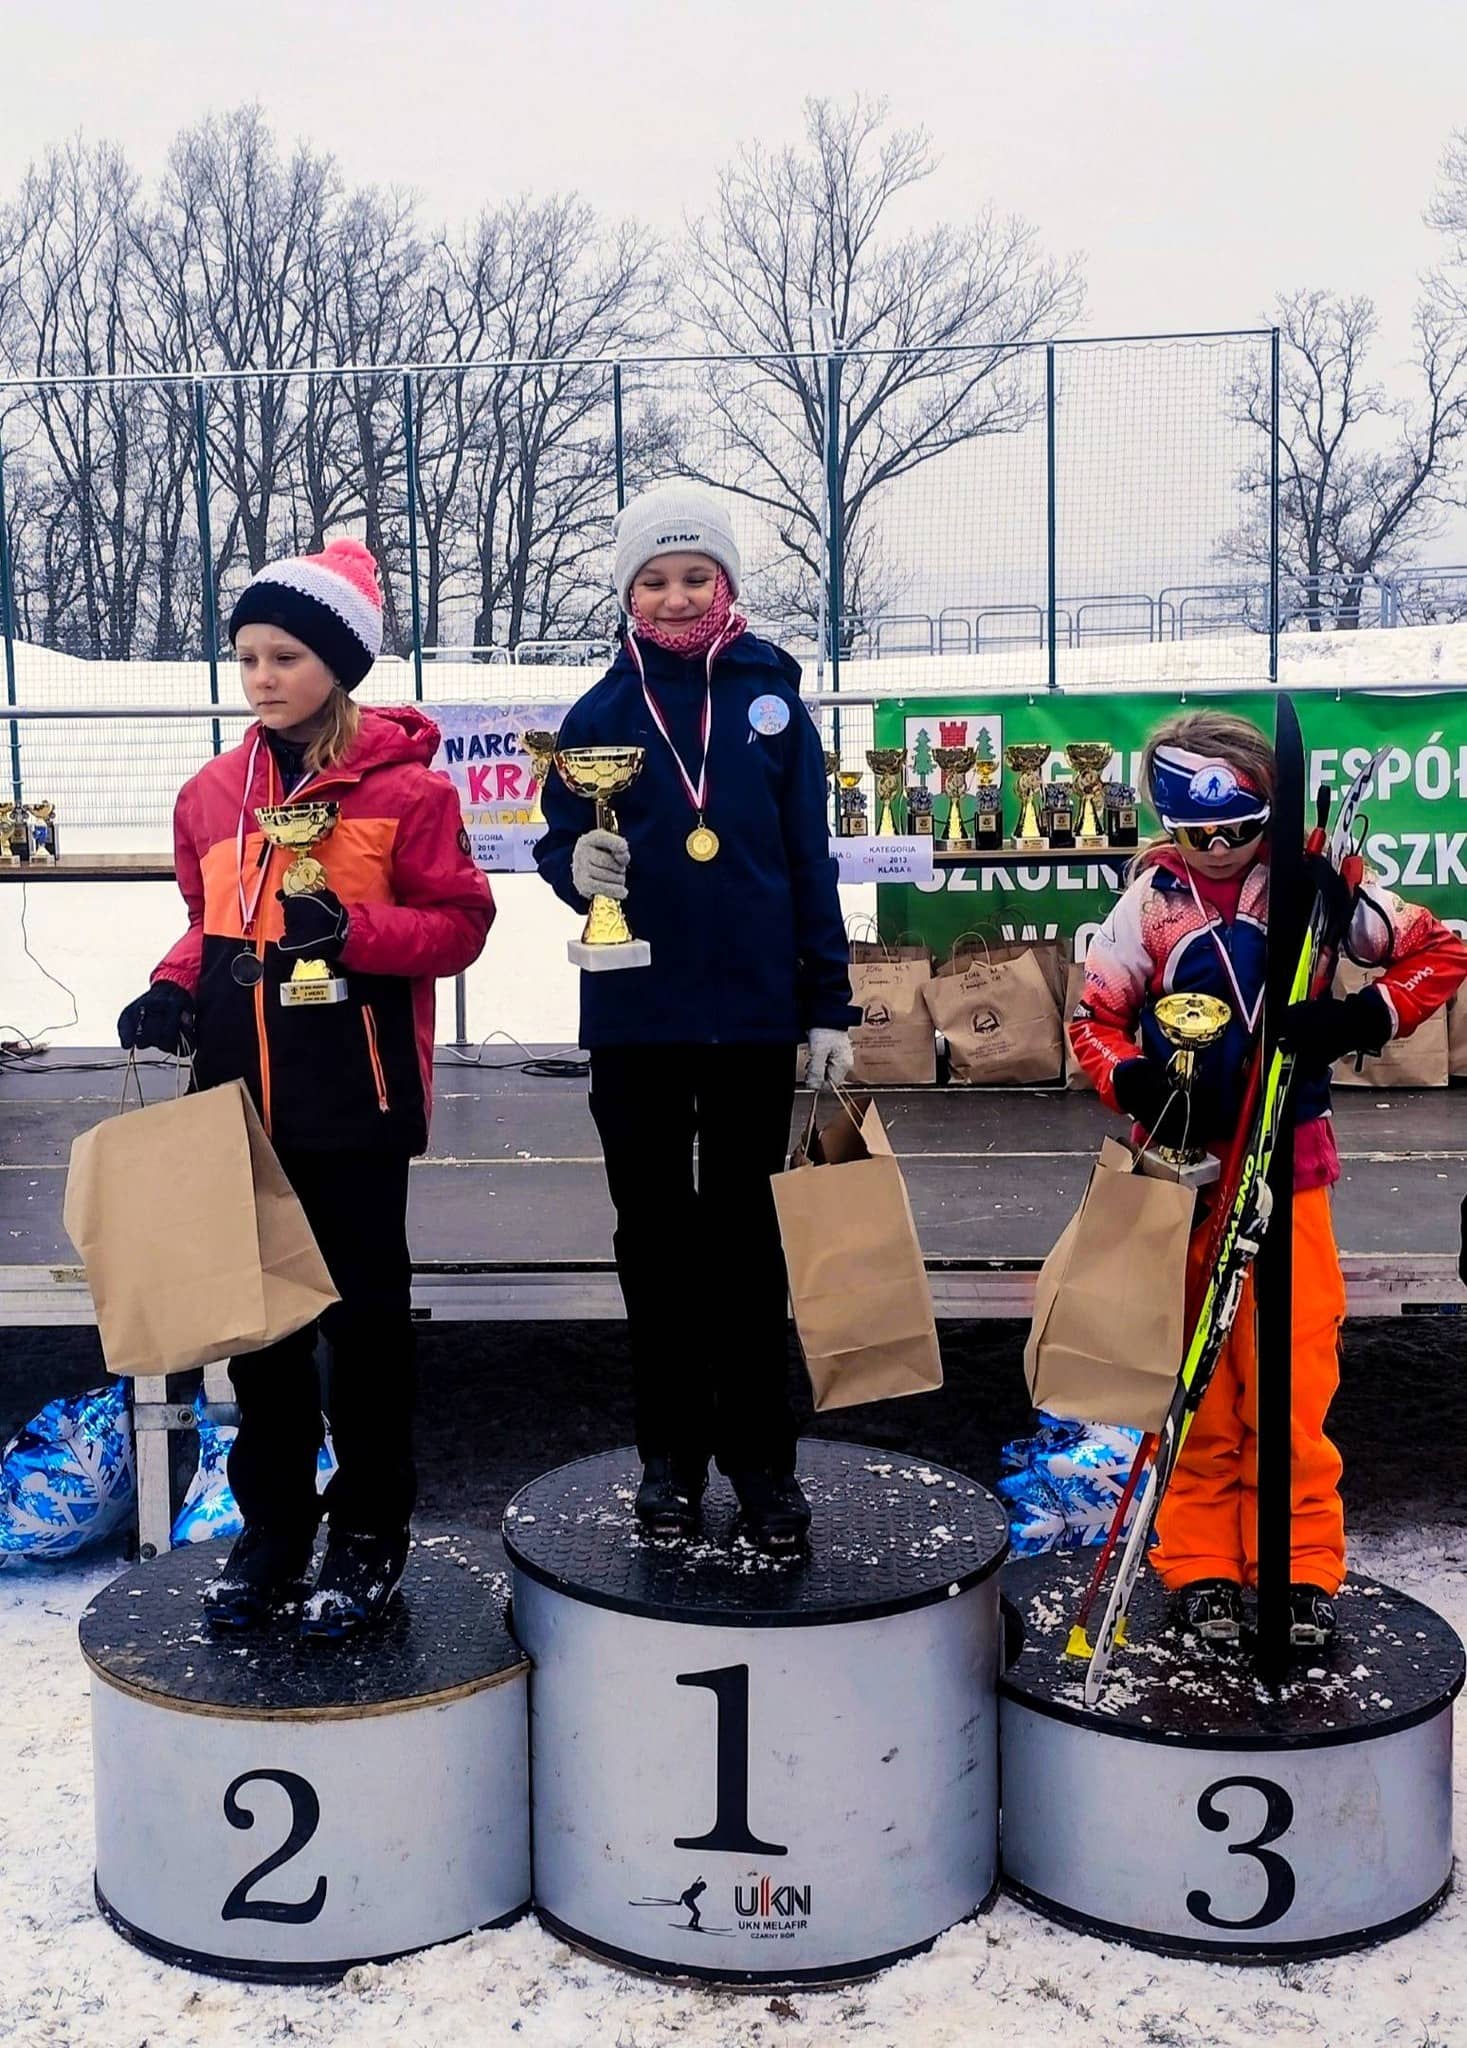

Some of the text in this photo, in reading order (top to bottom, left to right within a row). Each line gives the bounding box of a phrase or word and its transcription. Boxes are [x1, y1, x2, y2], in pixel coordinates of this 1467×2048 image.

[869, 846, 917, 854] KATEGORIA
[877, 866, 905, 874] KLASA
[674, 1663, 788, 1856] 1
[221, 1768, 328, 1924] 2
[1186, 1775, 1296, 1930] 3
[738, 1920, 808, 1930] UKN MELAFIR
